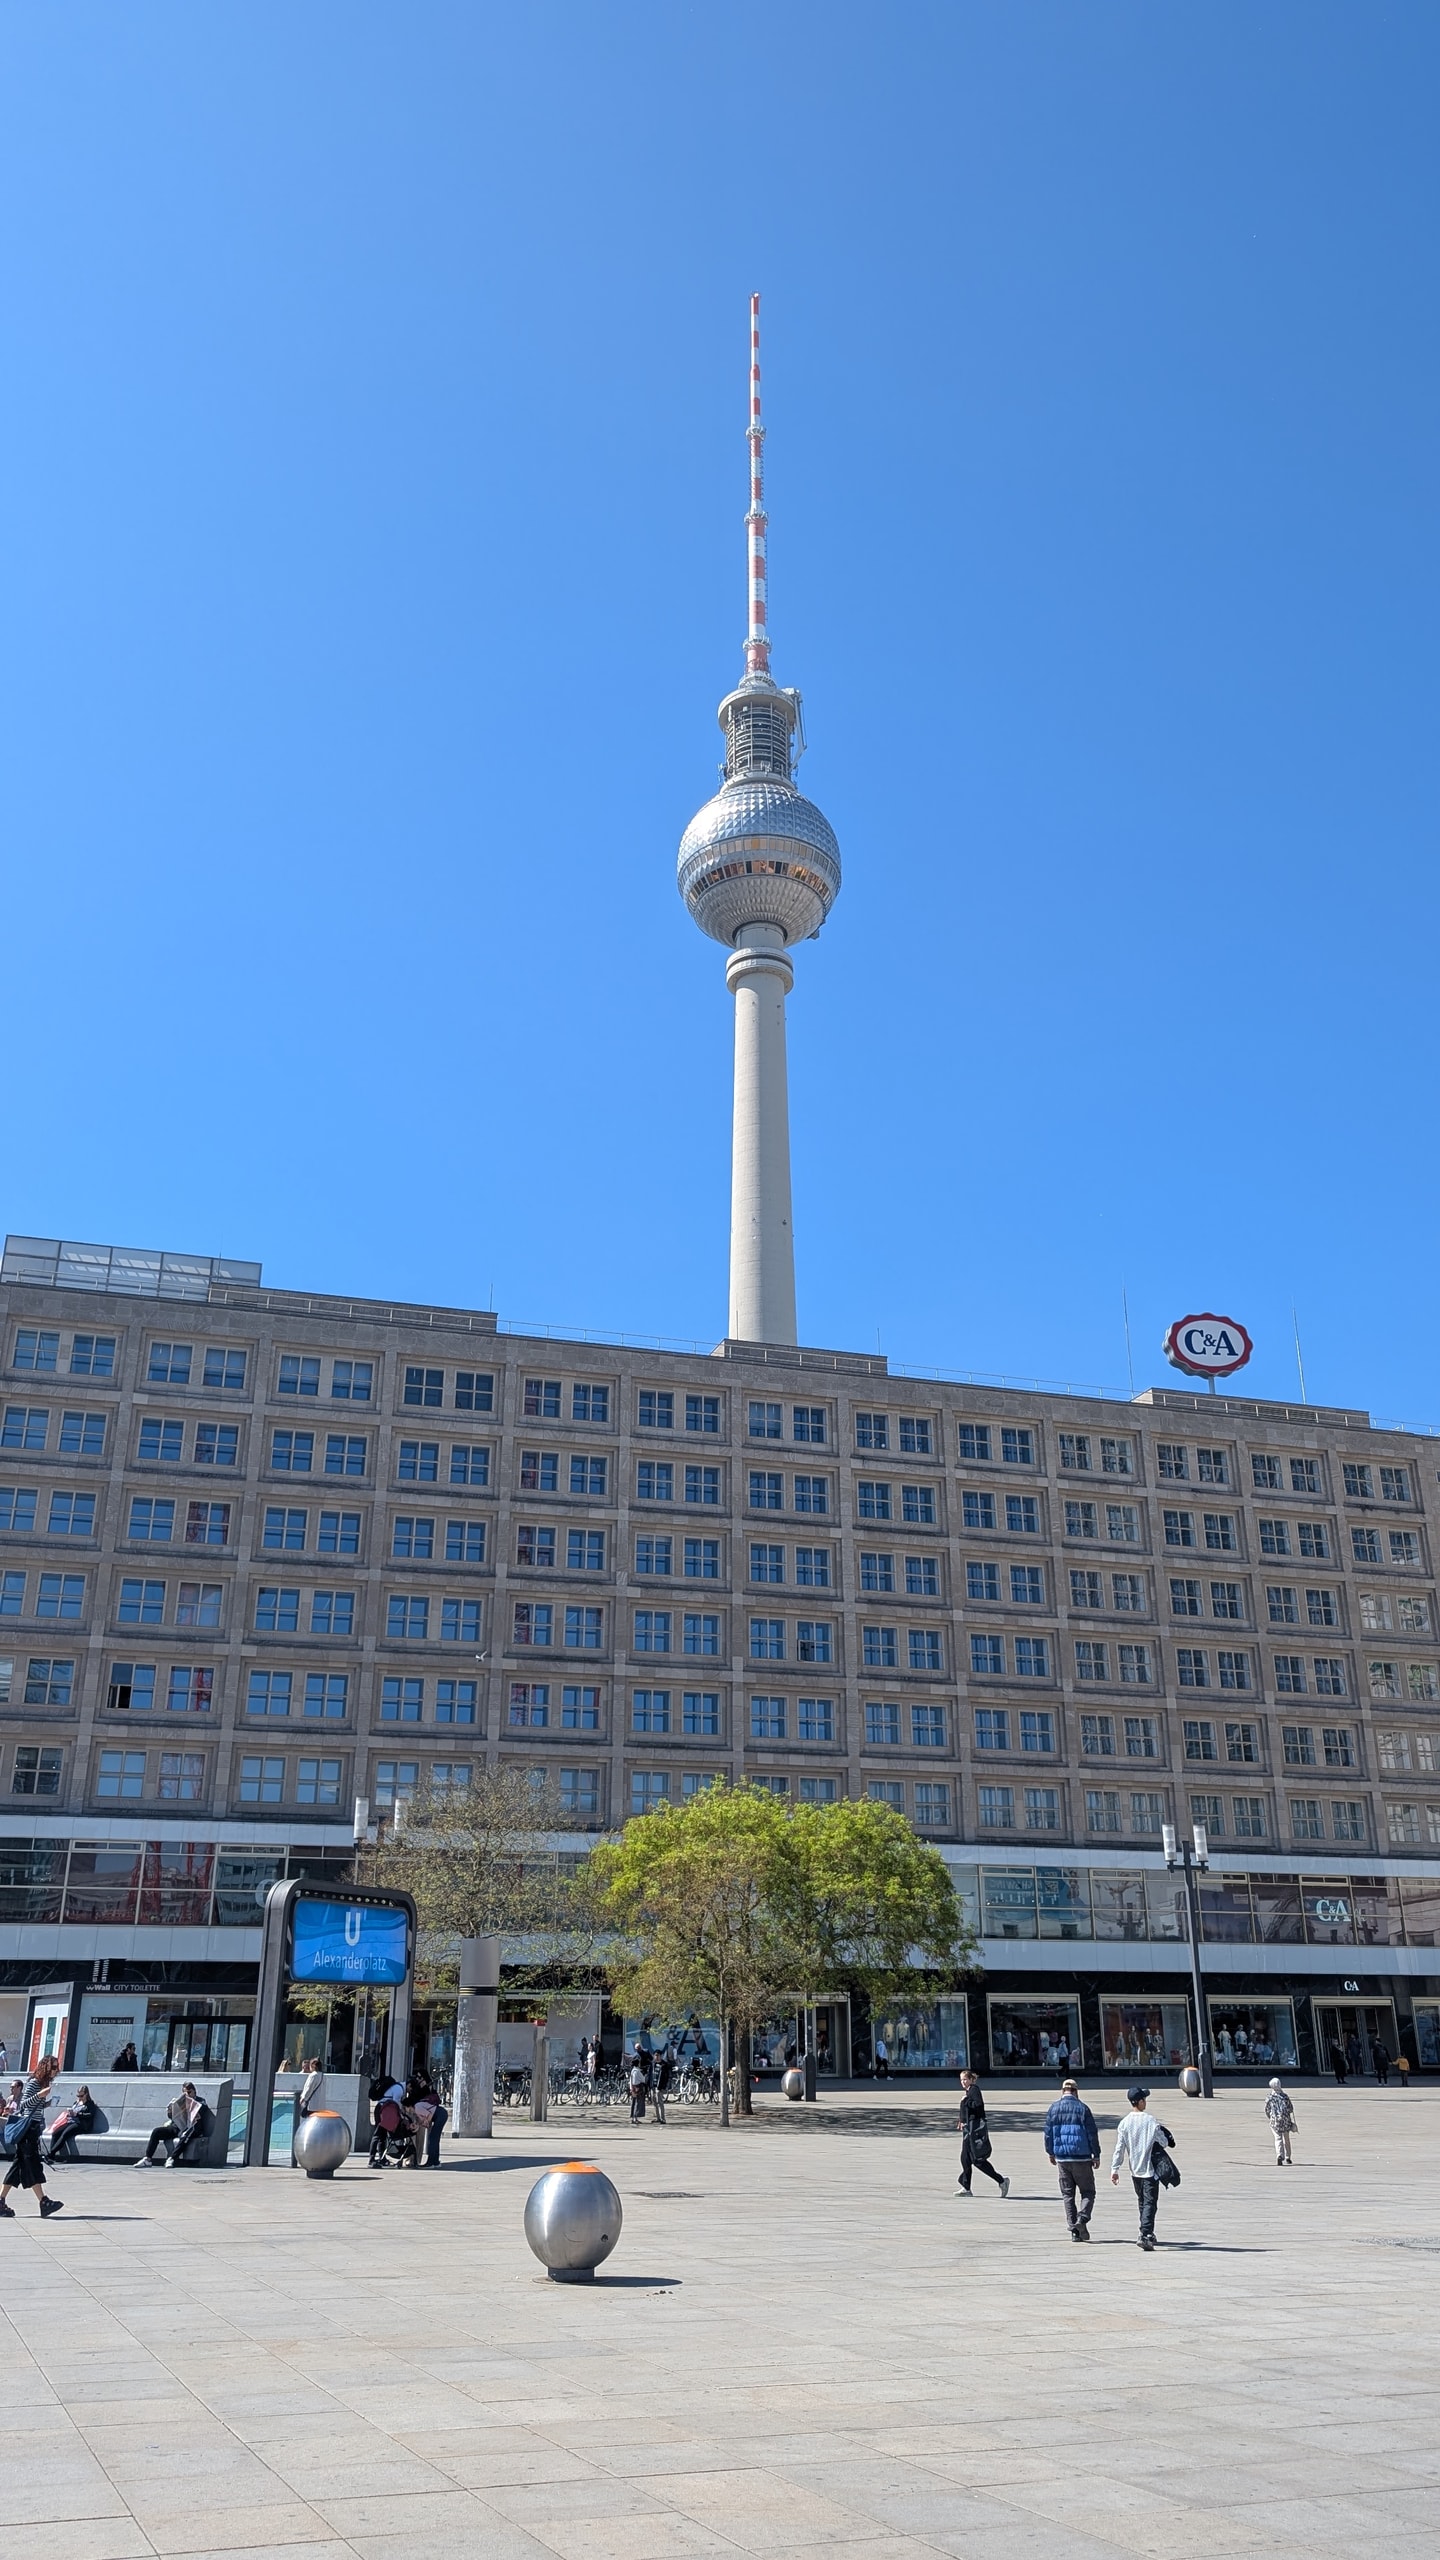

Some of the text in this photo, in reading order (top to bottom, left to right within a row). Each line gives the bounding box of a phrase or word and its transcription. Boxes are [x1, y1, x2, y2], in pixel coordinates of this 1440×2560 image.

[1184, 1329, 1239, 1356] C&A
[1316, 1899, 1352, 1922] C&A
[344, 1911, 361, 1947] U
[313, 1949, 387, 1971] Alexanderplatz
[130, 1984, 161, 1992] TOILETTE
[1344, 1980, 1360, 1991] C&A
